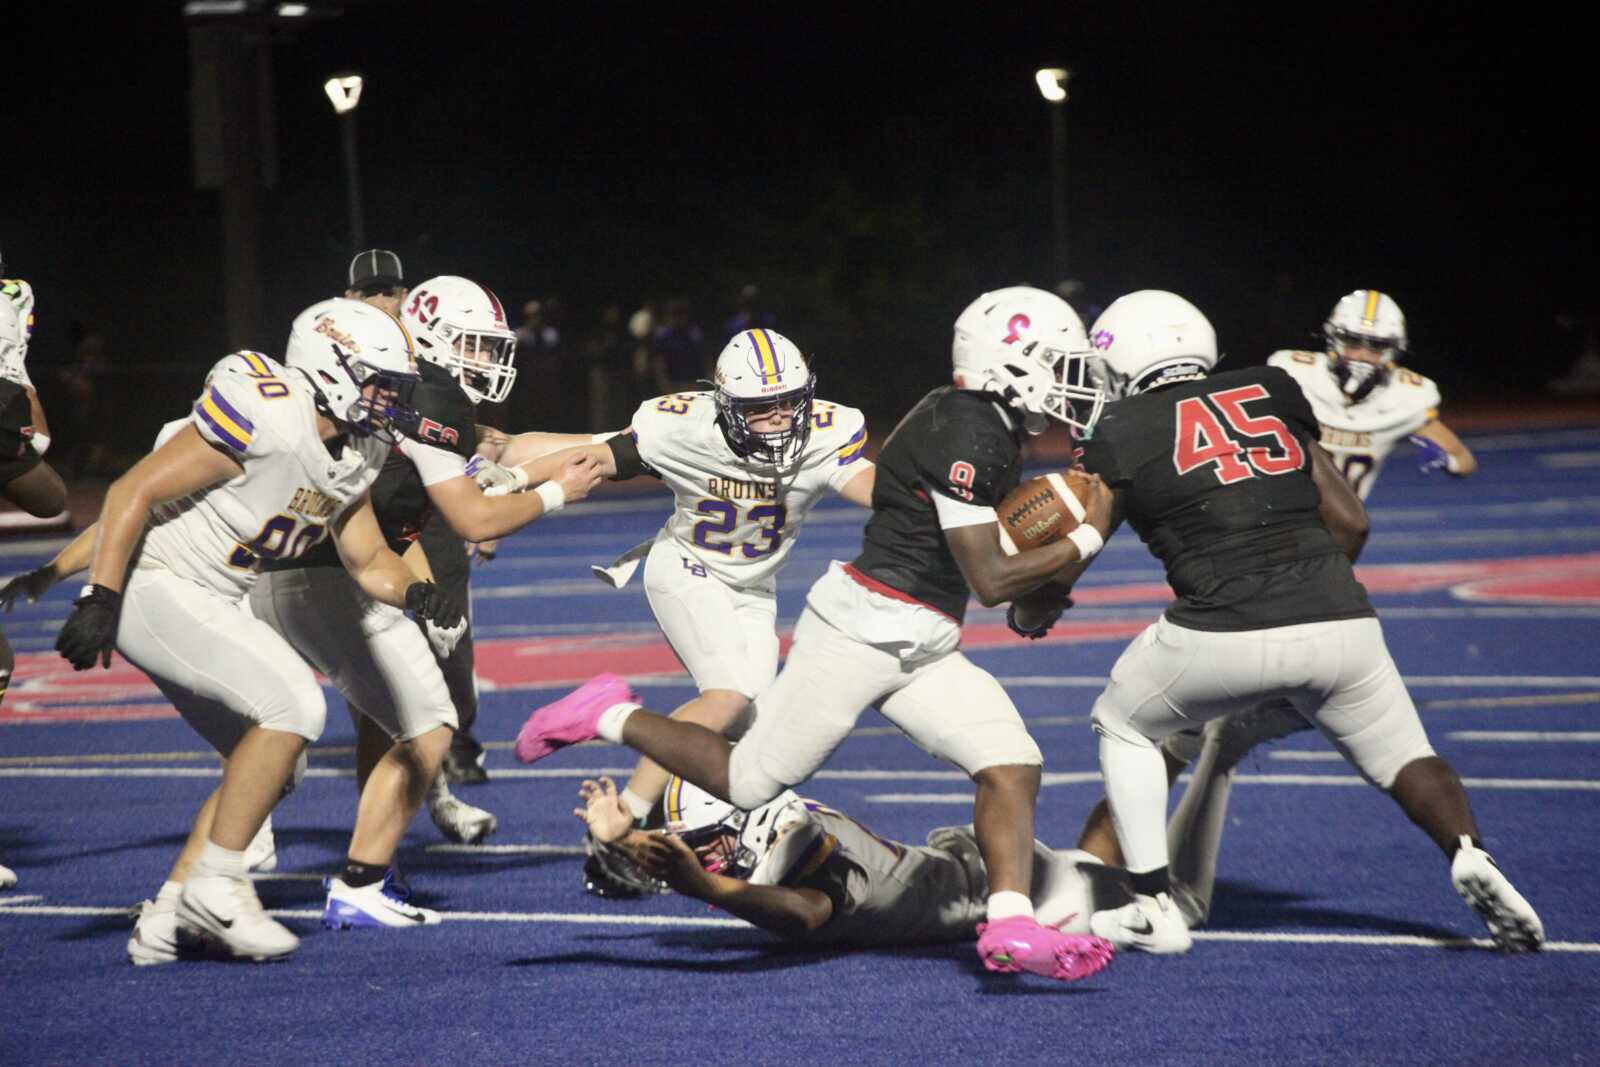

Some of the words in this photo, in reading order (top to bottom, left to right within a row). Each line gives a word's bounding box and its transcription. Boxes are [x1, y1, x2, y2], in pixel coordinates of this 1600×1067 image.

[1172, 383, 1305, 485] 45
[708, 478, 777, 499] BRUINS
[693, 498, 788, 558] 23
